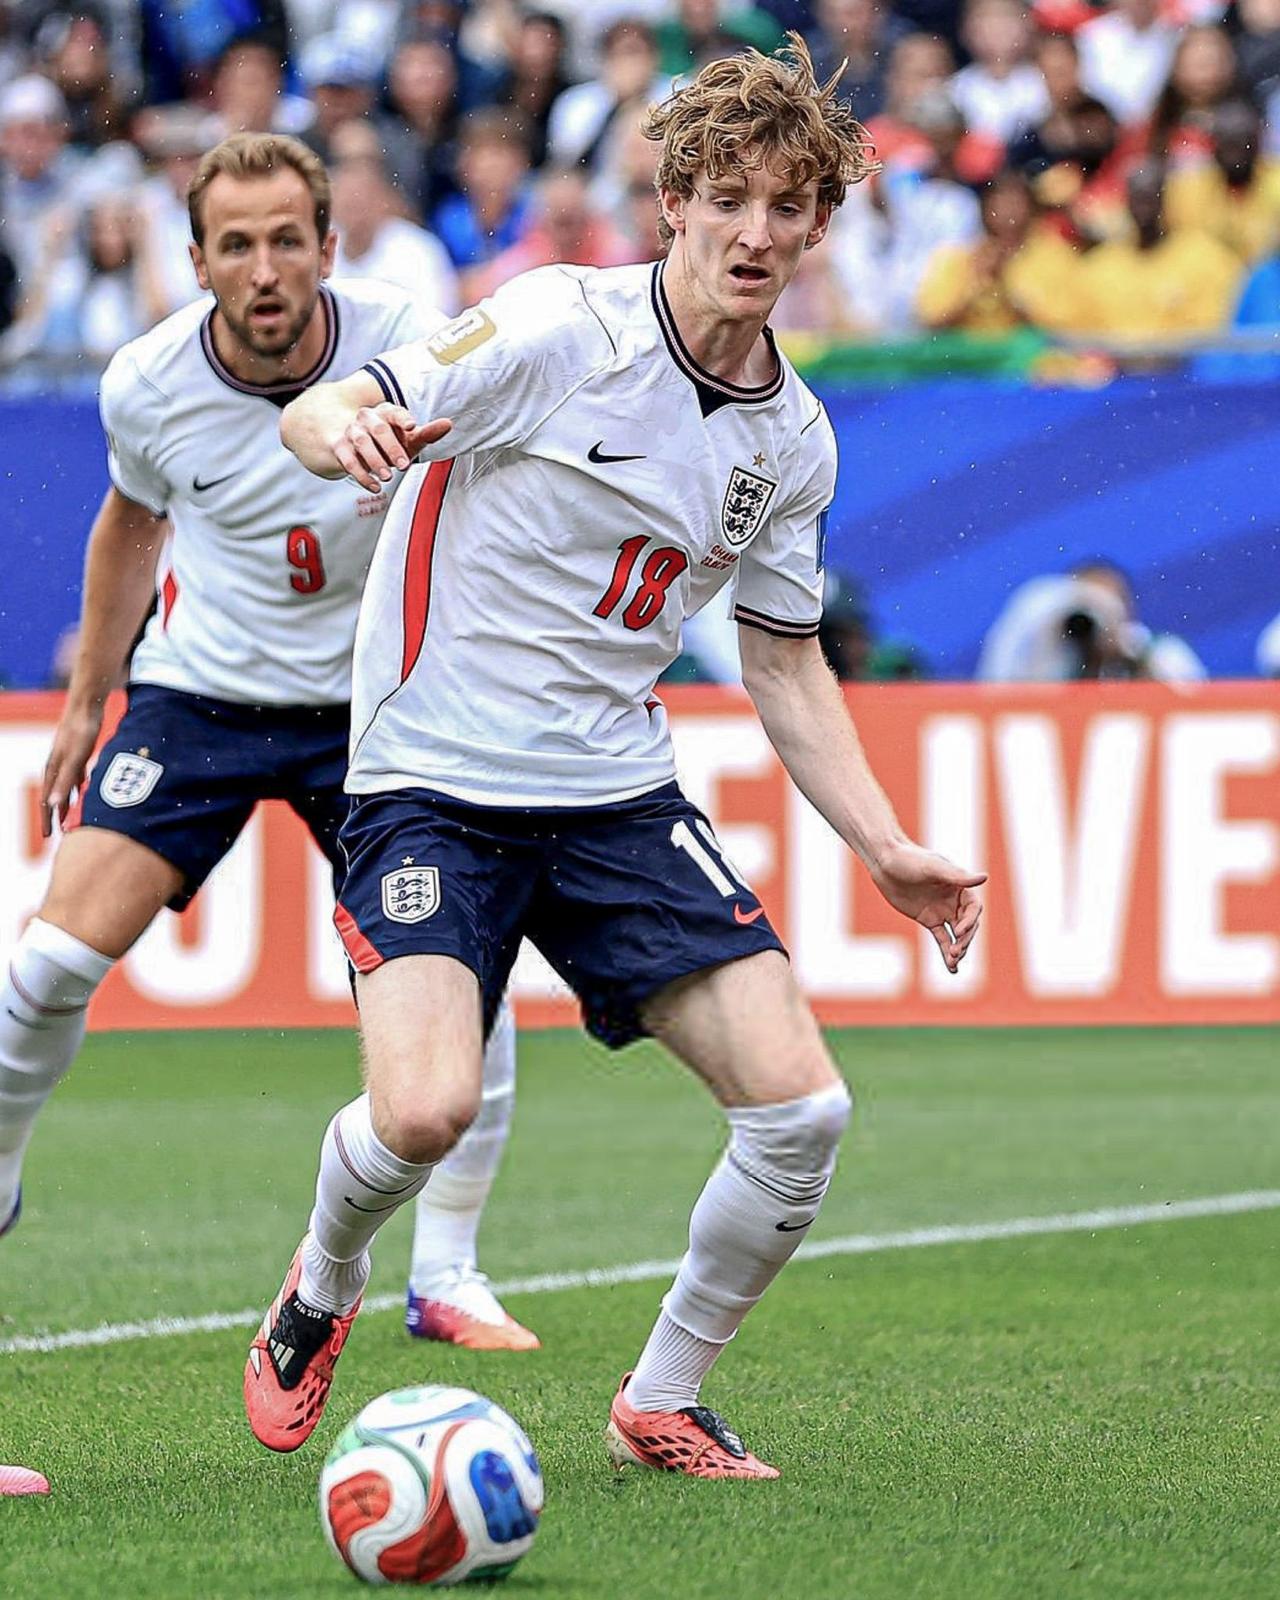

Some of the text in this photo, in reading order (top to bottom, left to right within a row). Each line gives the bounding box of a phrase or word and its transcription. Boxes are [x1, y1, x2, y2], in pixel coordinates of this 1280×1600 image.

[287, 524, 327, 594] 9
[592, 534, 688, 632] 18
[505, 713, 1279, 999] ELIVE
